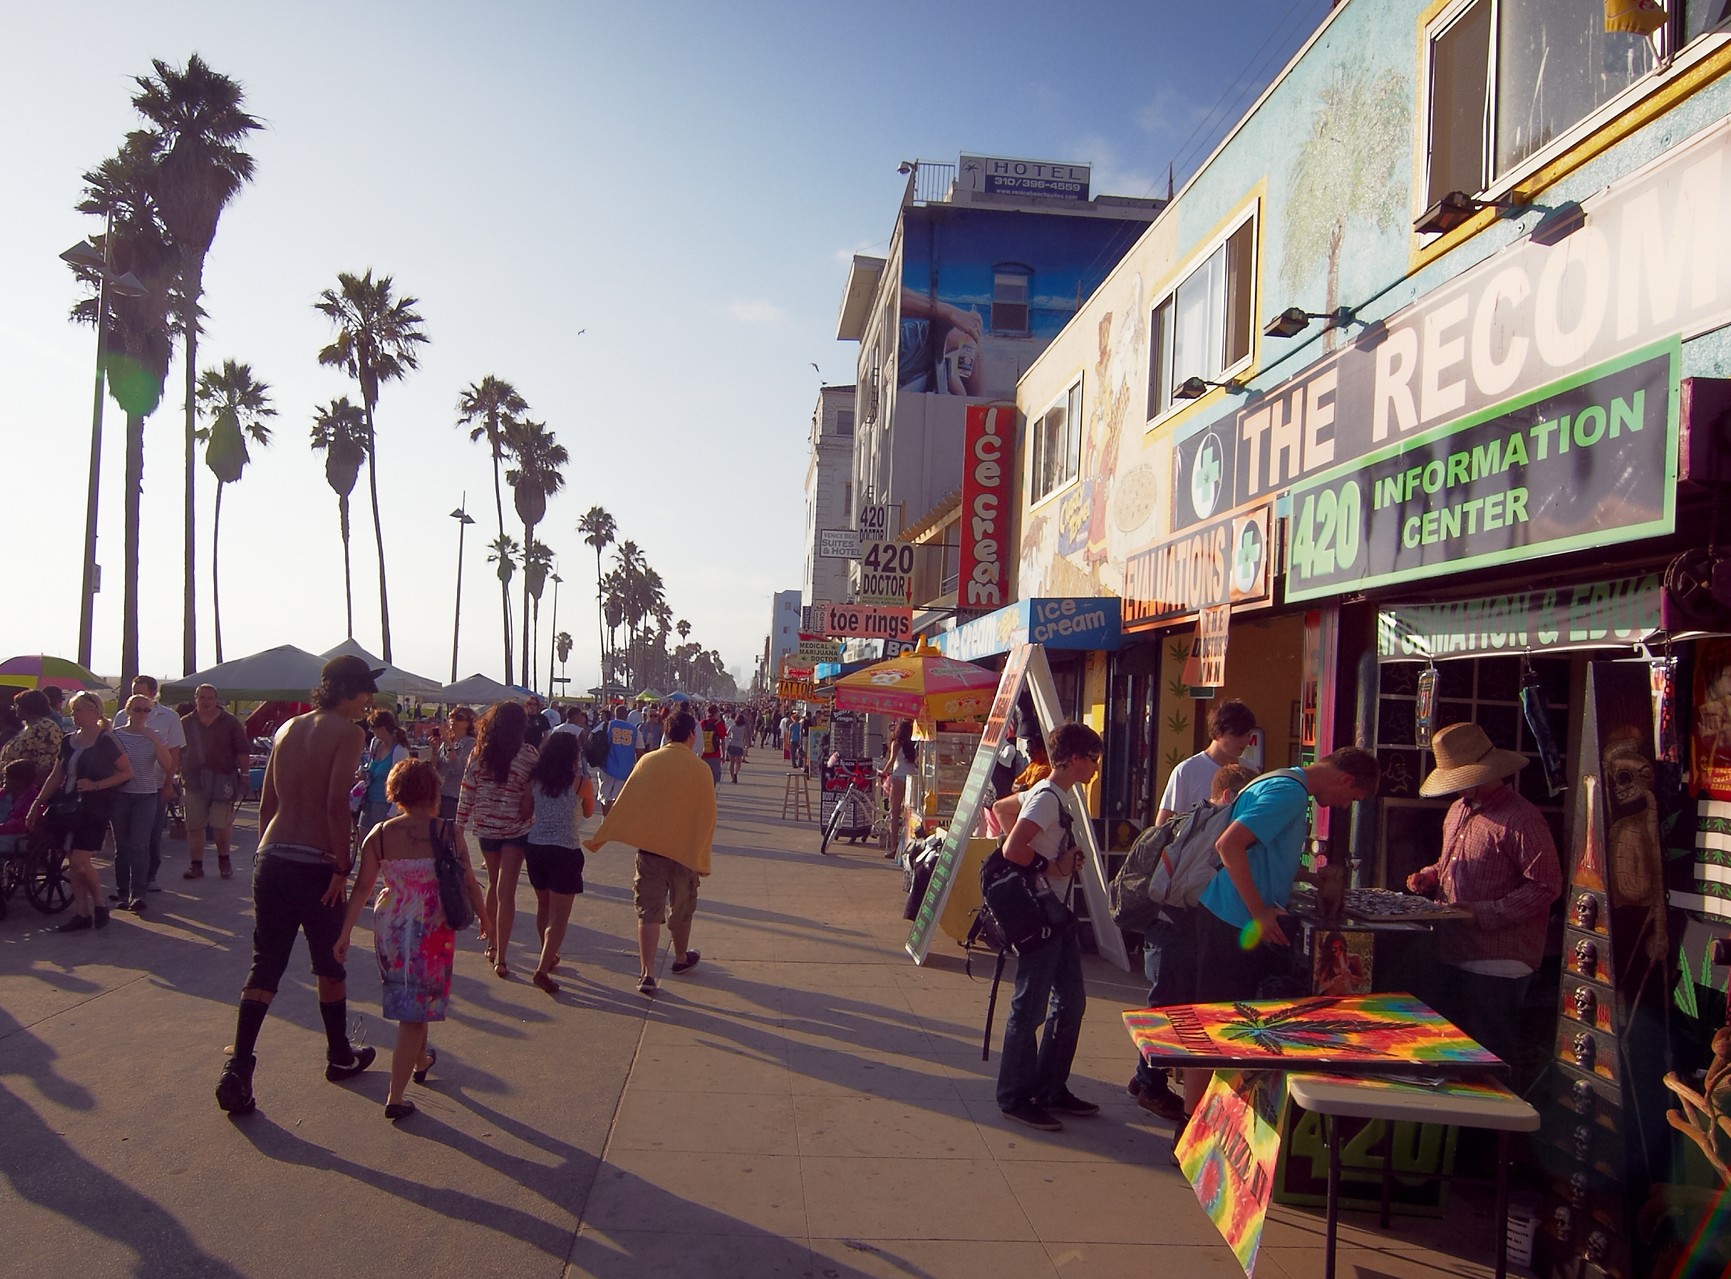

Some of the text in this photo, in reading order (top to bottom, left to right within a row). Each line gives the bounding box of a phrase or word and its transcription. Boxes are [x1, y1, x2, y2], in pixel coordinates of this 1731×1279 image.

[994, 161, 1081, 181] HOTEL
[994, 177, 1081, 192] 310/396-4559
[1243, 374, 1337, 496] THE
[1373, 390, 1646, 511] INFORMATION
[860, 505, 885, 528] 420
[966, 407, 1002, 606] Ice cream
[1402, 487, 1530, 550] CENTER
[822, 540, 854, 548] SUITES
[1292, 479, 1361, 580] 420
[864, 543, 914, 575] 420
[1125, 525, 1226, 622] EVALUATIONS
[863, 574, 905, 597] DOCTOR
[829, 607, 859, 632] toe
[864, 608, 909, 638] rings
[1034, 610, 1106, 642] cream
[1205, 610, 1224, 633] THE
[1538, 592, 1560, 646] &
[799, 642, 829, 650] MEDICAL
[799, 649, 838, 657] MARIJUANA
[779, 680, 814, 699] TATTOO
[1290, 1108, 1446, 1187] 420
